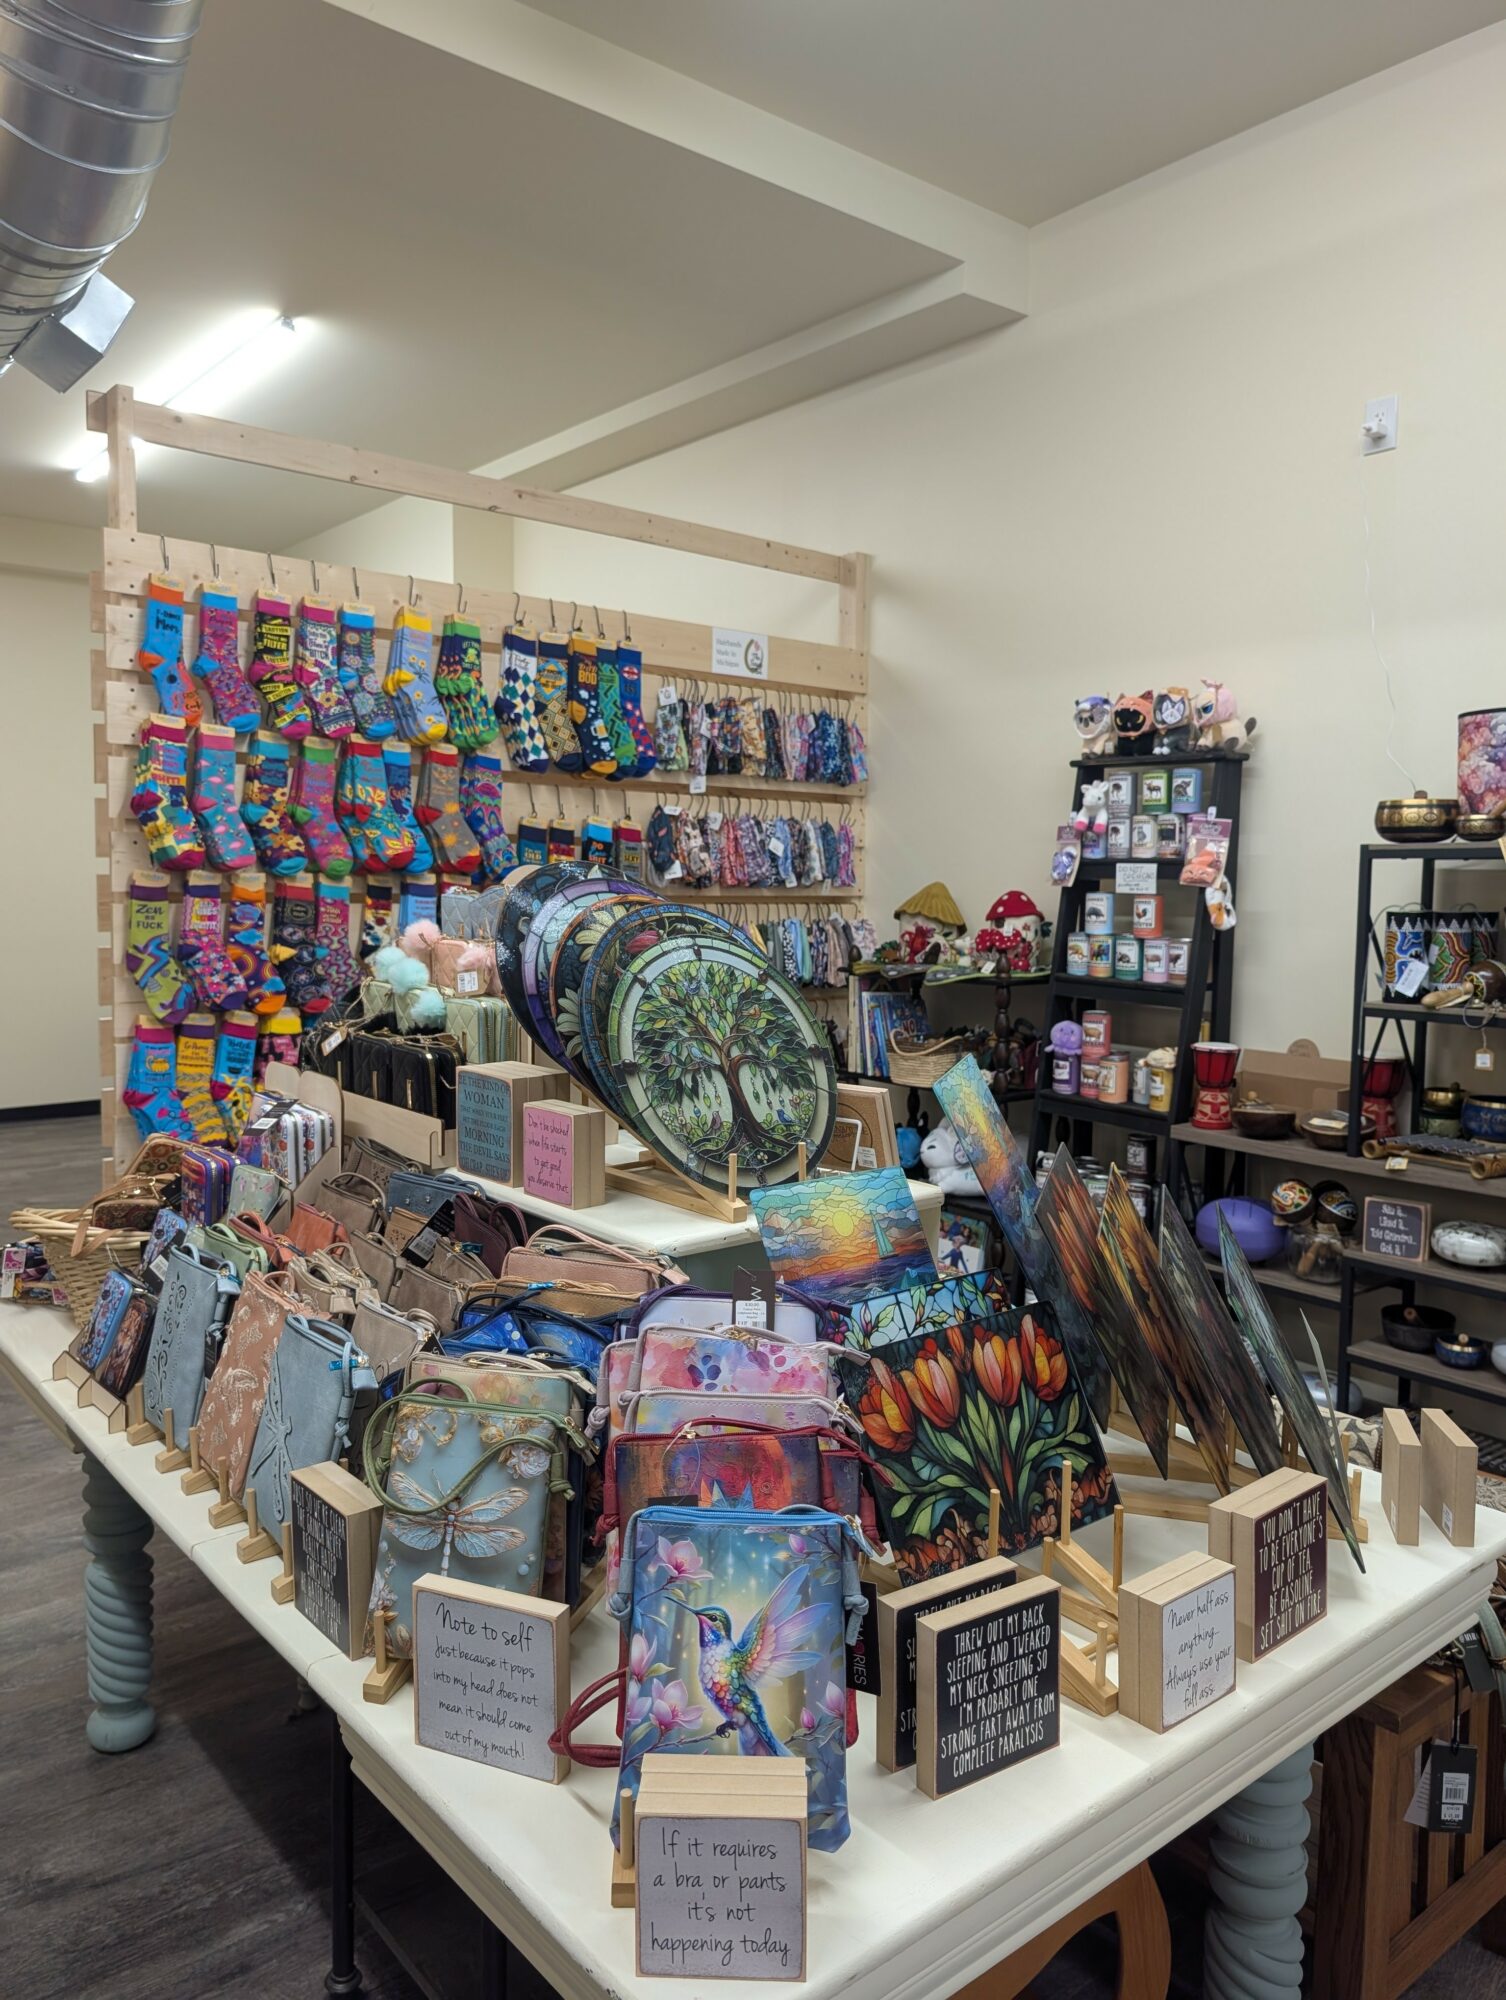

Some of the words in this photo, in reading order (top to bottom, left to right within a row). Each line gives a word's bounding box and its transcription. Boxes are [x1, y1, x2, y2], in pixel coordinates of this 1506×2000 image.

[136, 904, 163, 915] Zen
[136, 920, 163, 929] FUCK
[464, 1089, 504, 1110] WOMAN
[468, 1077, 481, 1088] THE
[481, 1079, 499, 1092] KIND
[501, 1082, 510, 1093] OF
[464, 1127, 504, 1148] MORNING
[529, 1132, 540, 1147] when
[550, 1119, 569, 1136] shocked
[473, 1145, 493, 1158] DEVIL
[495, 1150, 510, 1163] SAYS
[534, 1156, 539, 1165] to
[1262, 1517, 1276, 1543] YOU
[1278, 1502, 1300, 1535] DON'T
[1303, 1491, 1321, 1523] HAVE
[1259, 1548, 1268, 1574] TO
[1271, 1543, 1279, 1566] BE
[1282, 1517, 1323, 1561] EVERYONE'S
[1272, 1565, 1284, 1591] CUP
[1288, 1560, 1295, 1582] OF
[1168, 1609, 1195, 1630] Never
[1197, 1590, 1214, 1617] half
[1214, 1591, 1229, 1607] ass
[1269, 1594, 1278, 1618] BE
[436, 1602, 477, 1636] Note
[482, 1621, 498, 1641] to
[502, 1621, 534, 1652] self
[955, 1627, 984, 1656] THREW
[987, 1618, 1004, 1642] OUT
[1007, 1612, 1019, 1636] MY
[1022, 1603, 1044, 1629] BACK
[1261, 1623, 1273, 1650] SET
[1277, 1611, 1292, 1640] SHIT
[1295, 1602, 1305, 1627] ON
[434, 1635, 457, 1658] Just
[459, 1642, 496, 1667] because
[499, 1657, 508, 1671] it
[511, 1663, 535, 1683] pops
[947, 1651, 986, 1684] SLEEPING
[990, 1640, 1009, 1664] AND
[1013, 1624, 1051, 1658] TWEAKED
[1166, 1665, 1198, 1690] Always
[1200, 1657, 1213, 1672] use
[1215, 1645, 1232, 1672] your
[433, 1669, 451, 1684] into
[454, 1676, 467, 1696] my
[470, 1672, 495, 1696] head
[496, 1681, 518, 1702] does
[521, 1694, 539, 1707] not
[950, 1682, 962, 1707] MY
[967, 1674, 989, 1700] NECK
[993, 1658, 1034, 1689] SNEEZING
[1037, 1648, 1048, 1671] SO
[1184, 1682, 1198, 1711] full
[438, 1699, 464, 1716] mean
[465, 1704, 474, 1719] it
[477, 1702, 507, 1727] should
[509, 1720, 533, 1734] come
[959, 1701, 973, 1727] I'M
[977, 1683, 1019, 1719] PROBABLY
[1022, 1675, 1038, 1699] ONE
[444, 1729, 461, 1743] out
[462, 1729, 473, 1746] of
[474, 1738, 489, 1757] my
[491, 1740, 525, 1760] mouth!
[941, 1727, 976, 1759] STRONG
[980, 1715, 1002, 1740] FART
[1006, 1703, 1029, 1731] AWAY
[1033, 1692, 1055, 1721] FROM
[953, 1746, 995, 1778] COMPLETE
[999, 1720, 1044, 1758] PARALYSIS
[662, 1827, 680, 1858] If
[688, 1838, 704, 1857] it
[713, 1839, 777, 1871] requires
[653, 1875, 665, 1888] a
[675, 1862, 703, 1888] bra
[713, 1875, 729, 1888] or
[739, 1871, 788, 1902] pants
[687, 1892, 717, 1922] it's
[727, 1901, 756, 1922] not
[651, 1922, 735, 1966] happening
[740, 1927, 791, 1966] today
